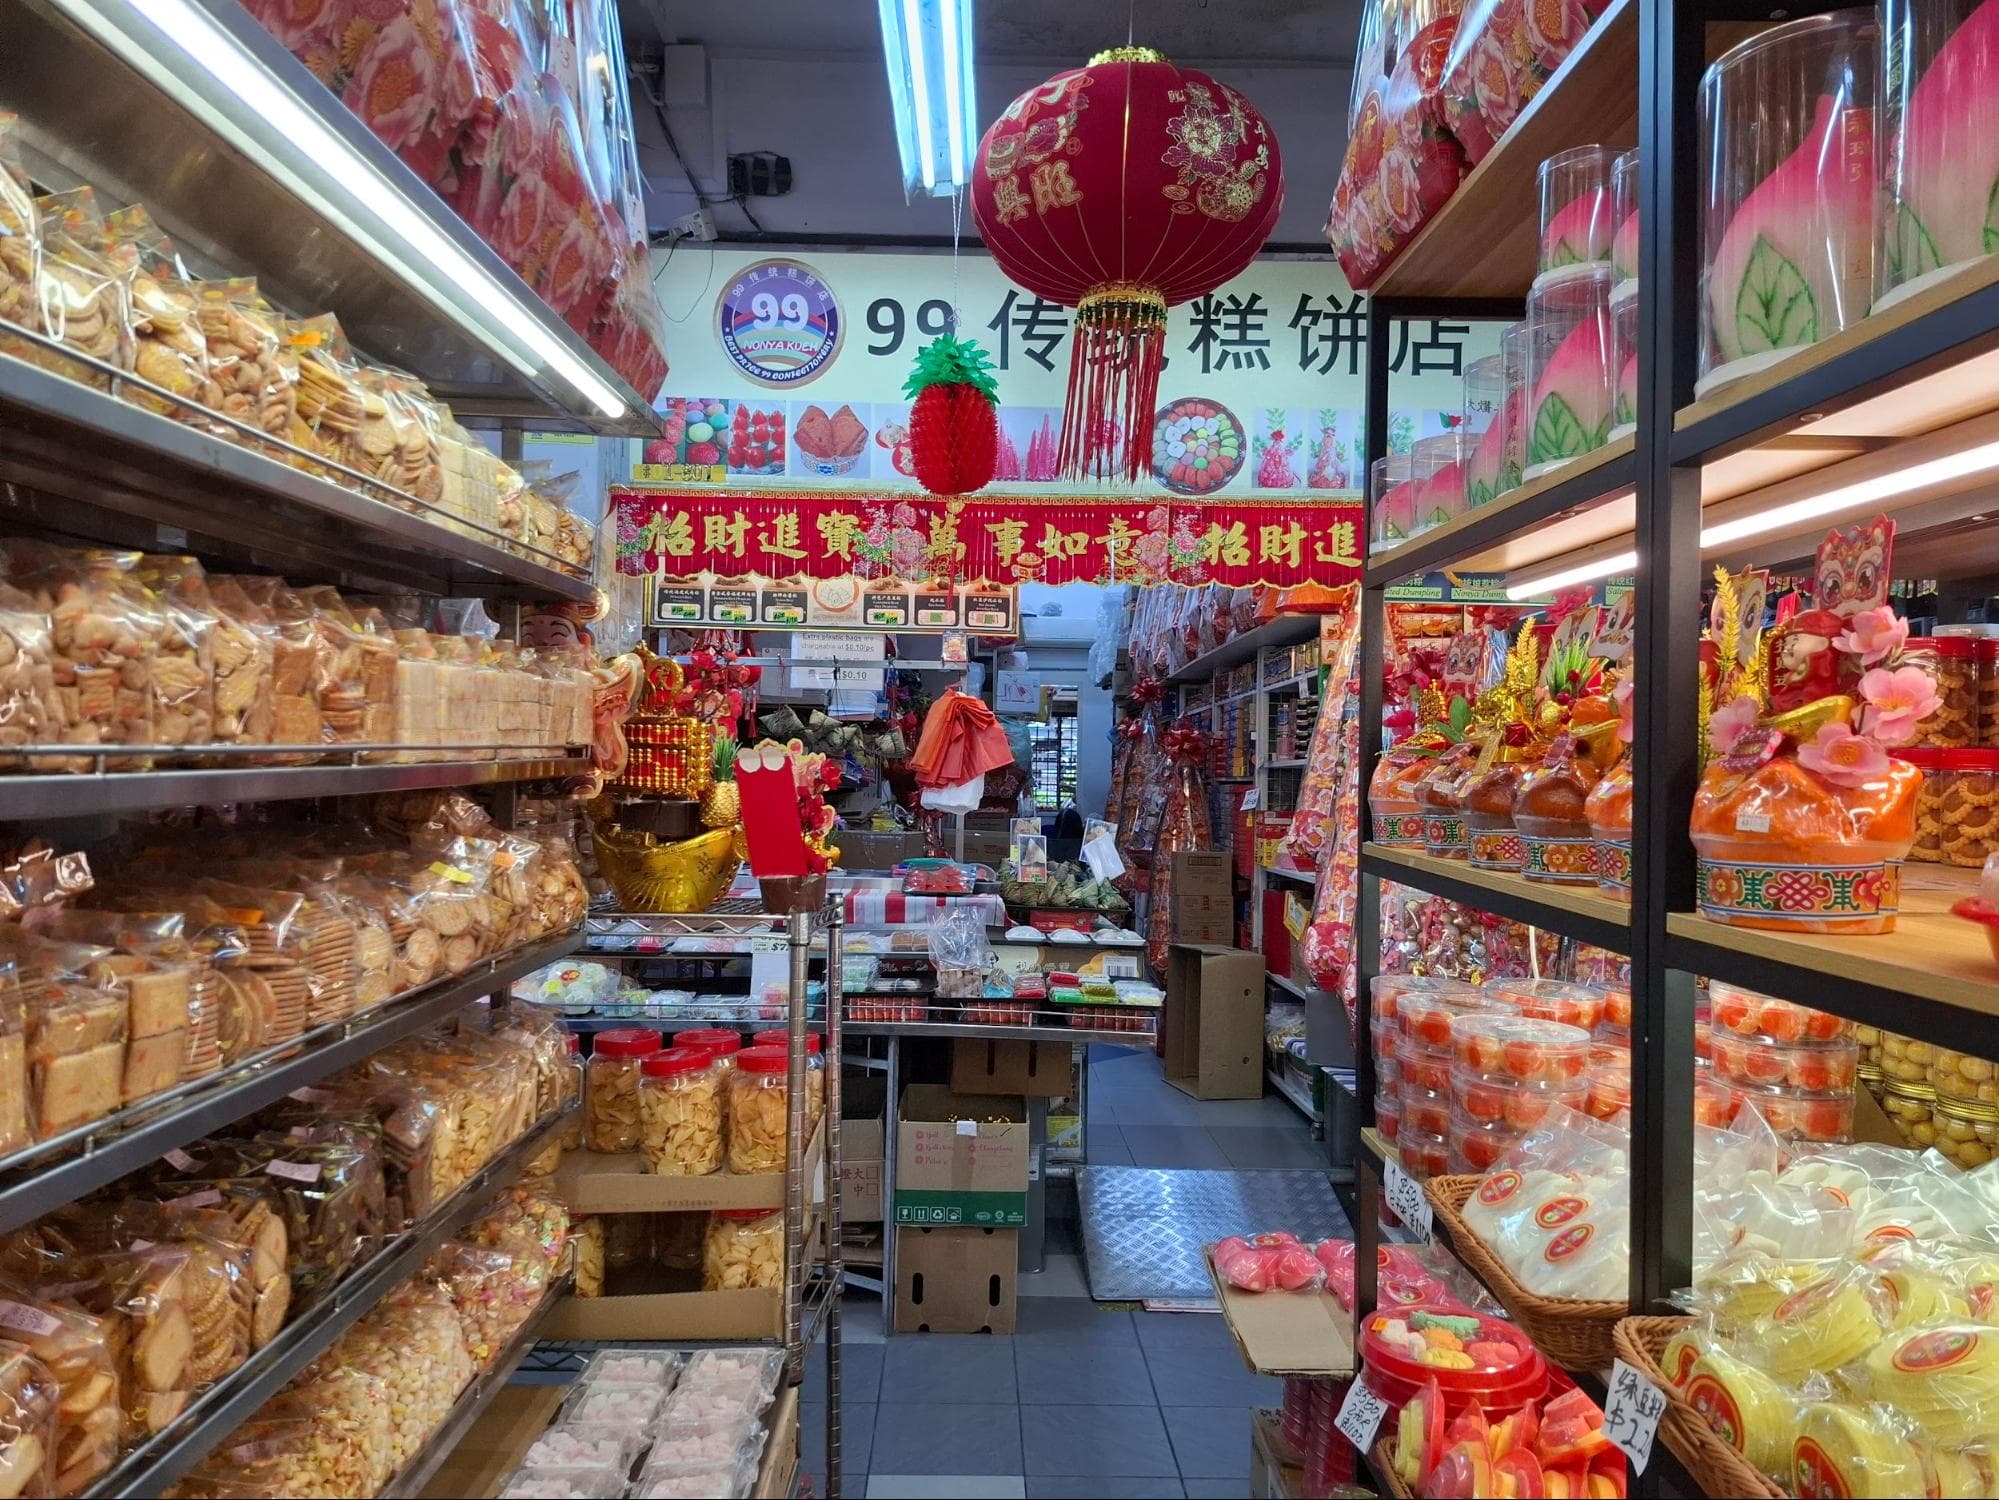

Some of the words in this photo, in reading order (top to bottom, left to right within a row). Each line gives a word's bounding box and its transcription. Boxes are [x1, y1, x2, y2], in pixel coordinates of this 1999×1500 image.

[751, 292, 809, 332] 99
[987, 288, 1470, 377] 传糕饼店
[724, 334, 741, 357] BEST
[738, 355, 762, 375] PRICE
[761, 369, 771, 379] 99
[743, 340, 784, 351] NONYA
[786, 341, 818, 352] KUEH
[648, 510, 862, 562] 招財進寶
[924, 514, 1146, 568] 萬事如意
[1202, 520, 1363, 568] 招財進
[1403, 588, 1440, 597] Dumpling
[802, 632, 820, 641] Extra
[822, 634, 842, 642] plastic
[845, 634, 862, 642] bags
[842, 670, 867, 680] $0.10
